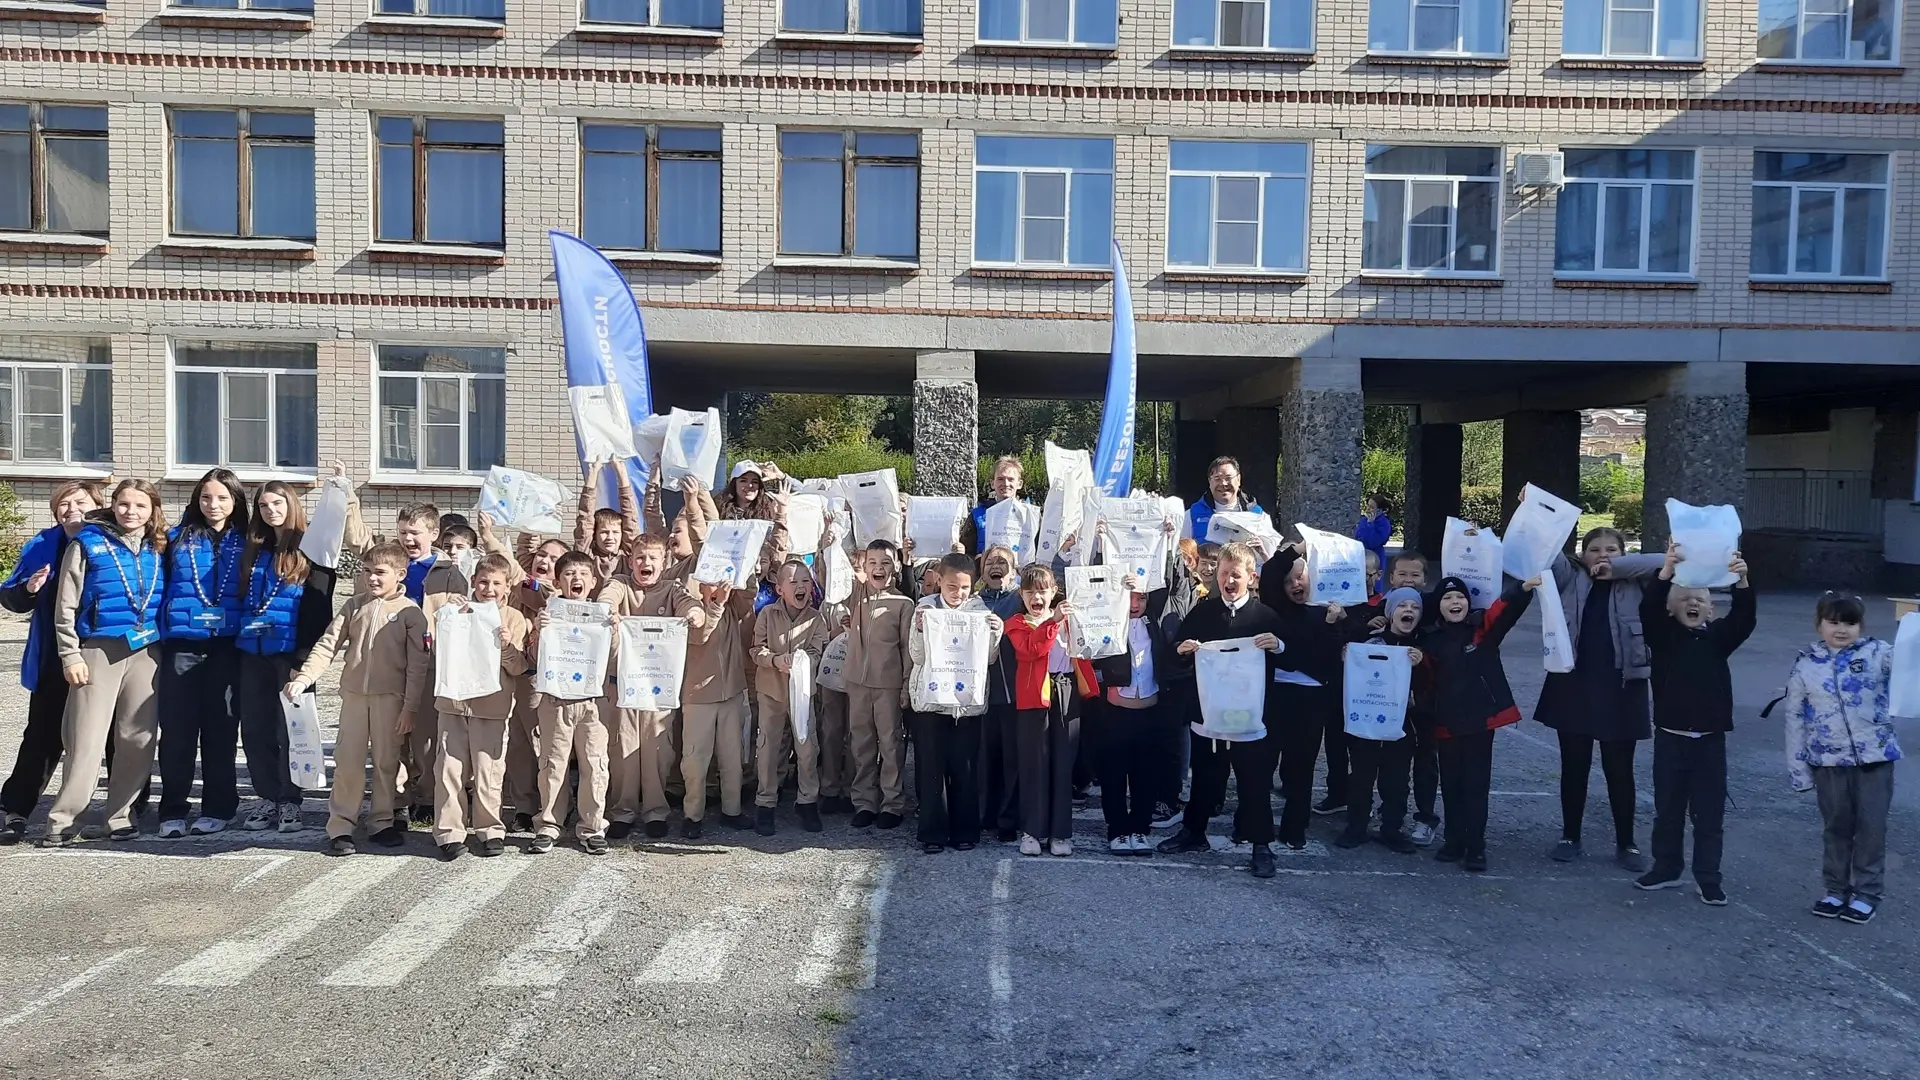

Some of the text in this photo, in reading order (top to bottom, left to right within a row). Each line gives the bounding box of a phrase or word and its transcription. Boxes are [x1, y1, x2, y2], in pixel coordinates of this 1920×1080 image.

[1446, 572, 1492, 581] БЕЗОПАСНОСТИ
[548, 656, 597, 665] БЕЗОПАСНОСТИ
[1352, 699, 1399, 707] БЕЗОПАСНОСТИ
